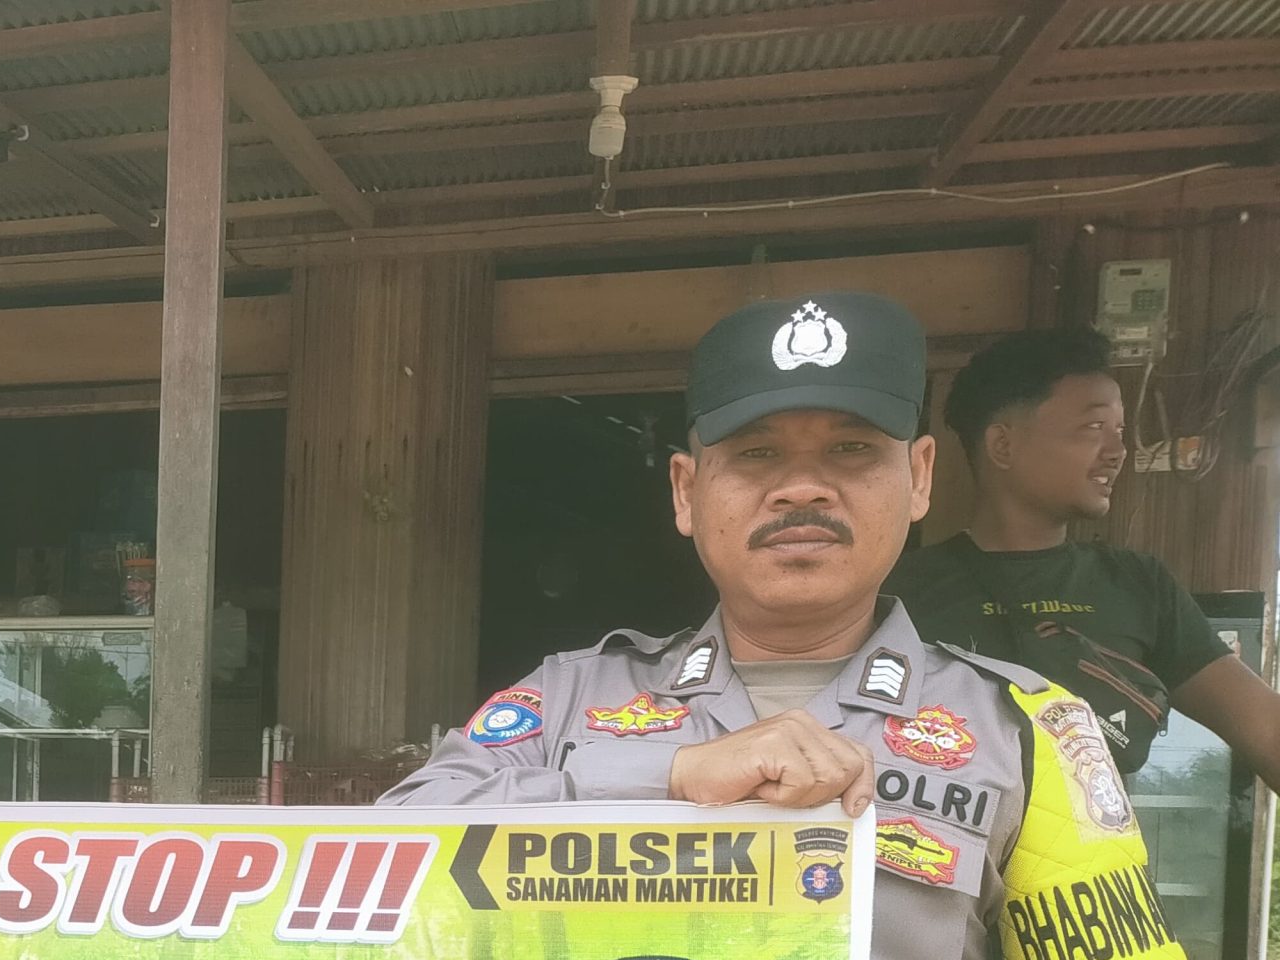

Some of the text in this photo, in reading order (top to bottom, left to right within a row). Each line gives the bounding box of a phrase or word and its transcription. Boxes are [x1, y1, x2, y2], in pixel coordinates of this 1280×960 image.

[877, 769, 988, 826] OLRI
[506, 831, 758, 876] POLSEK
[288, 841, 419, 932] !!!
[506, 877, 758, 904] SANAMAN MANTIKEI
